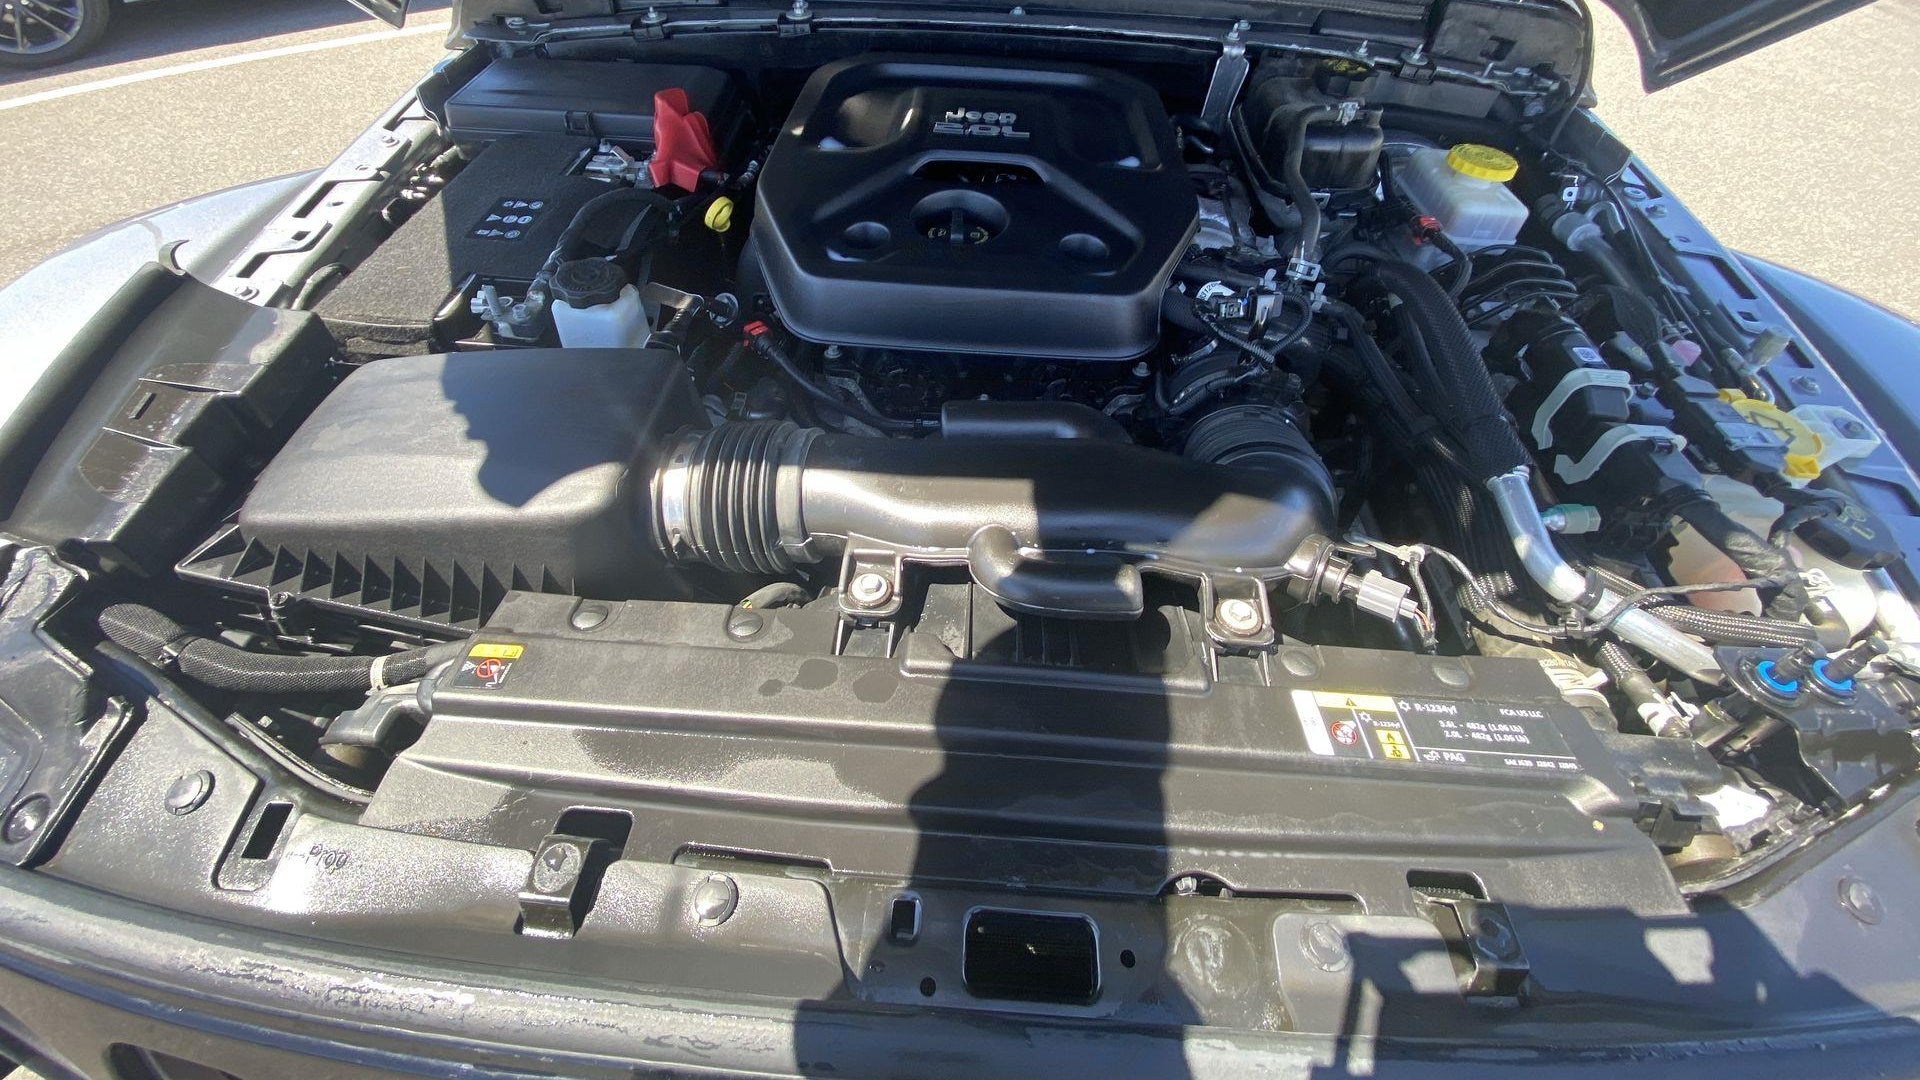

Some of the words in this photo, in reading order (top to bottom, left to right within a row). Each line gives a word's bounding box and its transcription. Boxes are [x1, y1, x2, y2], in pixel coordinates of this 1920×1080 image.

[945, 107, 1017, 124] Jeep
[1414, 703, 1458, 714] R-1234yf
[1499, 708, 1516, 716] FCA
[1516, 709, 1529, 717] US
[1528, 710, 1544, 718] LLC
[1442, 752, 1466, 763] PAG
